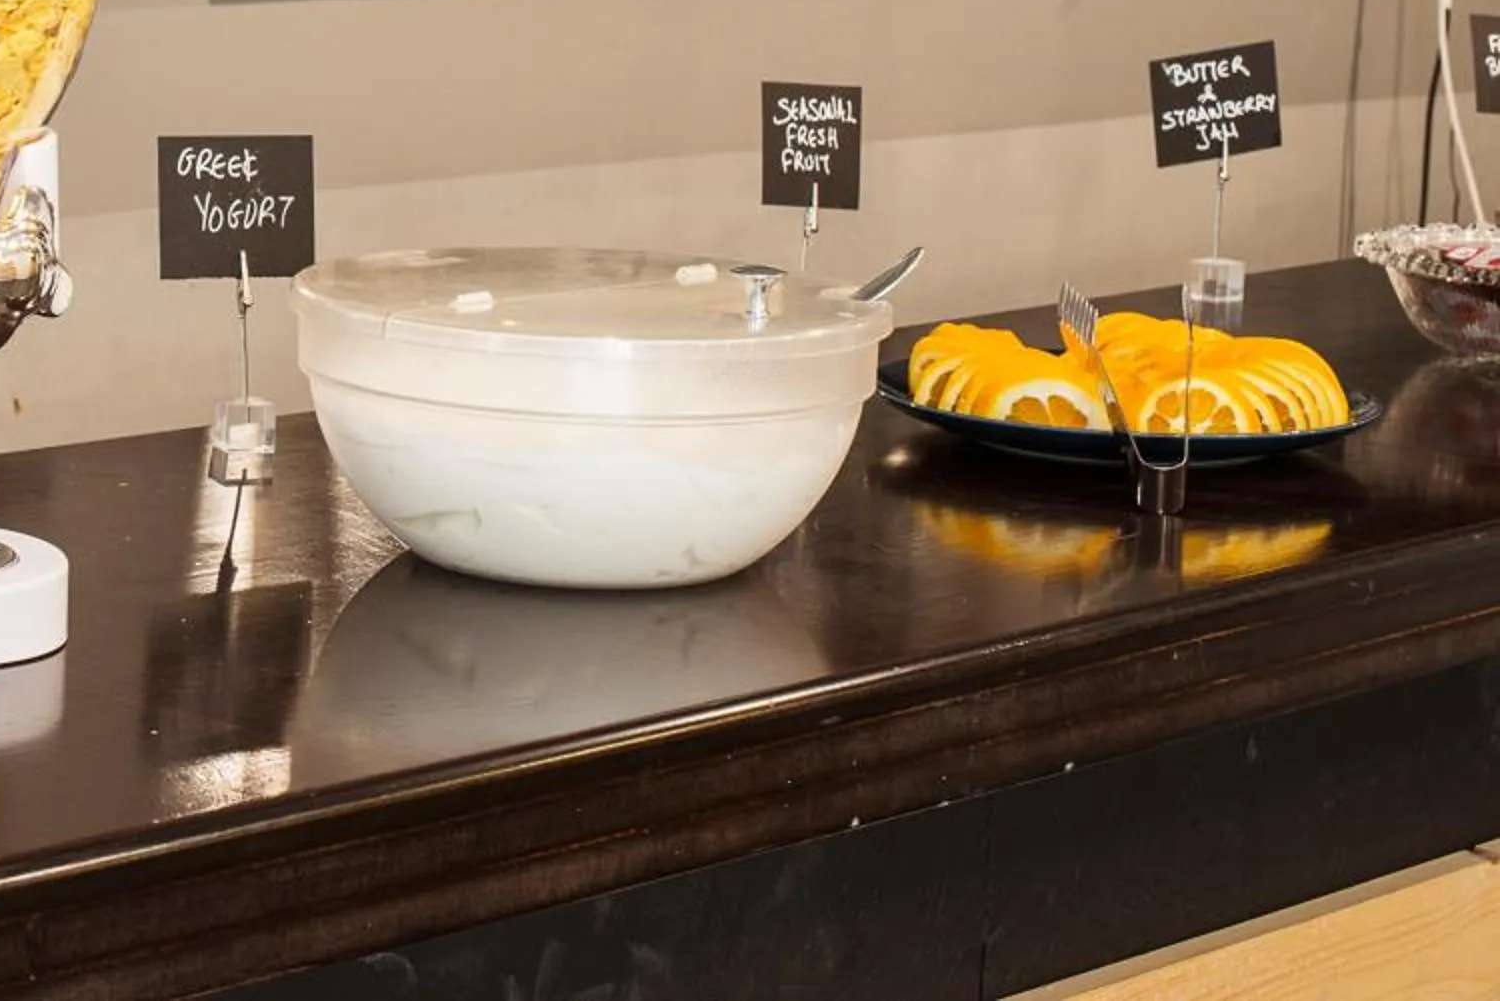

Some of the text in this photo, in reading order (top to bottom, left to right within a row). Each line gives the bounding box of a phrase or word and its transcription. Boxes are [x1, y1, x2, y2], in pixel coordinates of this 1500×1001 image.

[1163, 55, 1251, 87] BUTTER
[773, 95, 857, 126] SEASONAL
[785, 122, 839, 150] FRESH
[177, 146, 259, 182] GREEK
[781, 148, 831, 175] FRUIT
[194, 191, 296, 234] YOGURT
